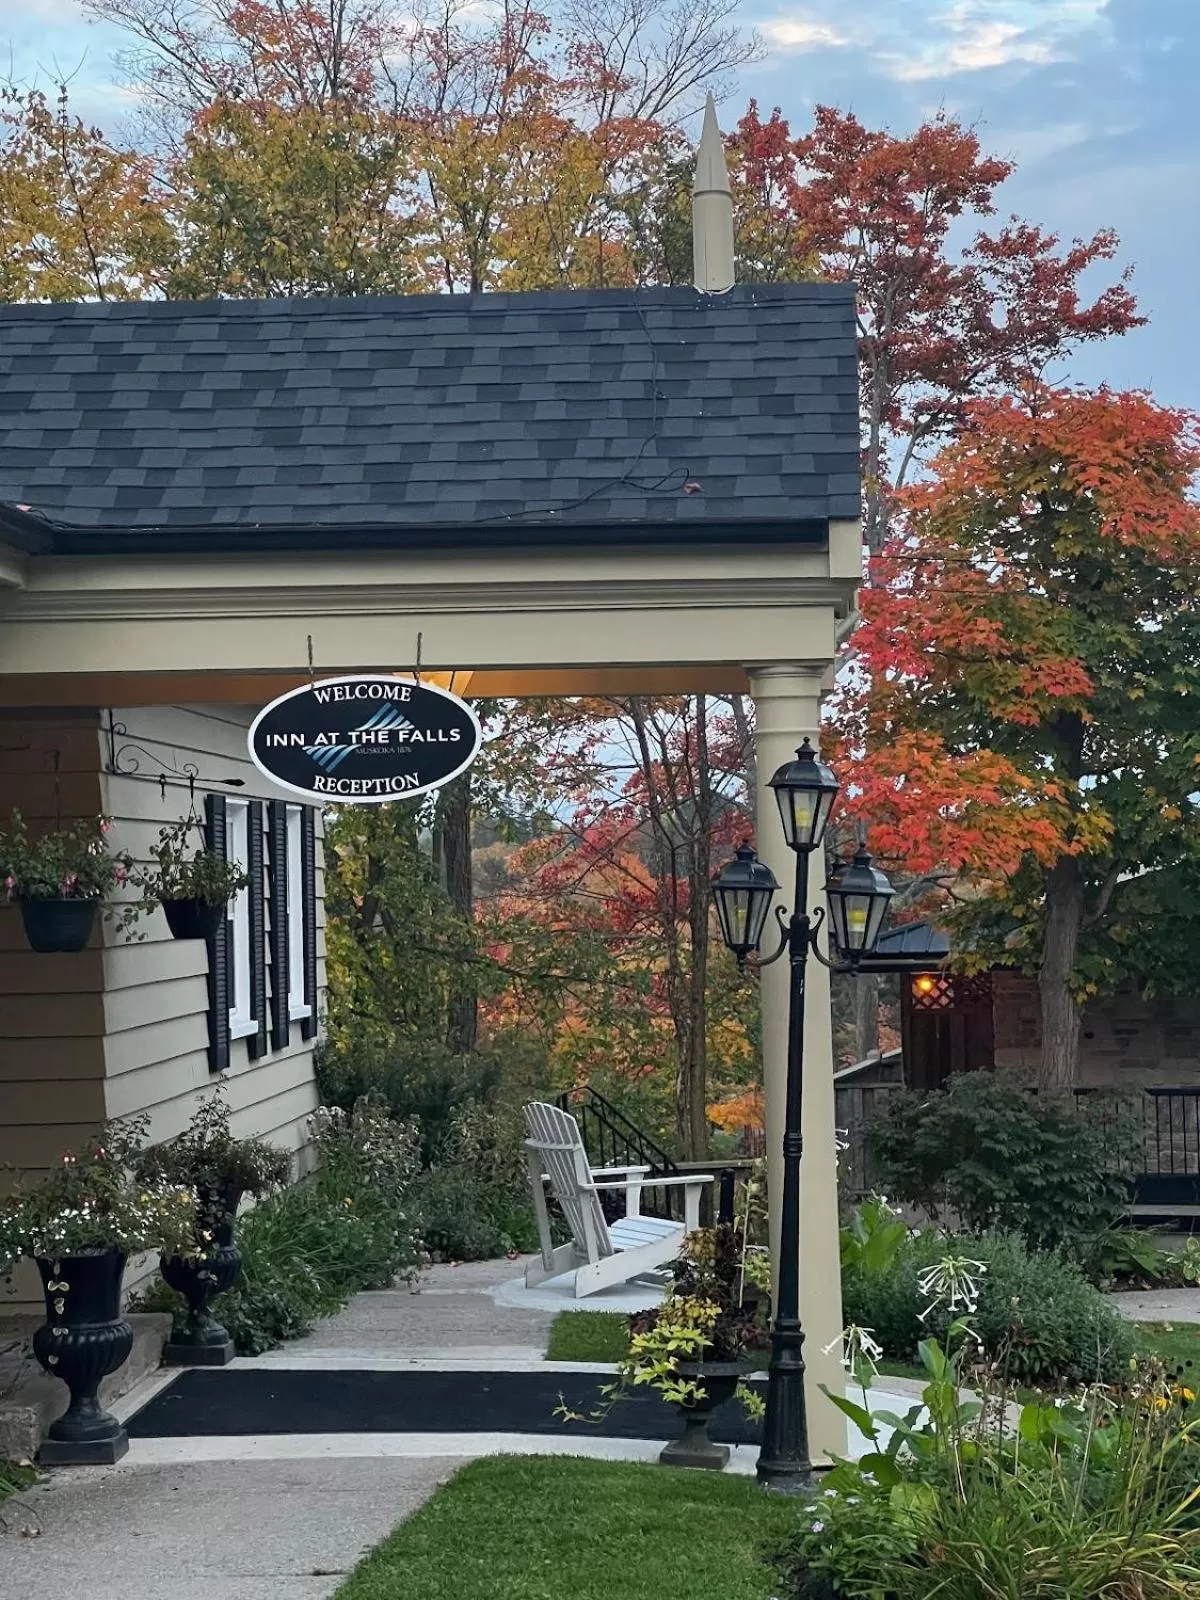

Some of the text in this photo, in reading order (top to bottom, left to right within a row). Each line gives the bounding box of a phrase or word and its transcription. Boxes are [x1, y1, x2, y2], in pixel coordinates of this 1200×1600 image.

[313, 684, 412, 705] WELCOME
[266, 728, 461, 748] INN AT THE FALLS
[313, 772, 420, 794] RECEPTION
